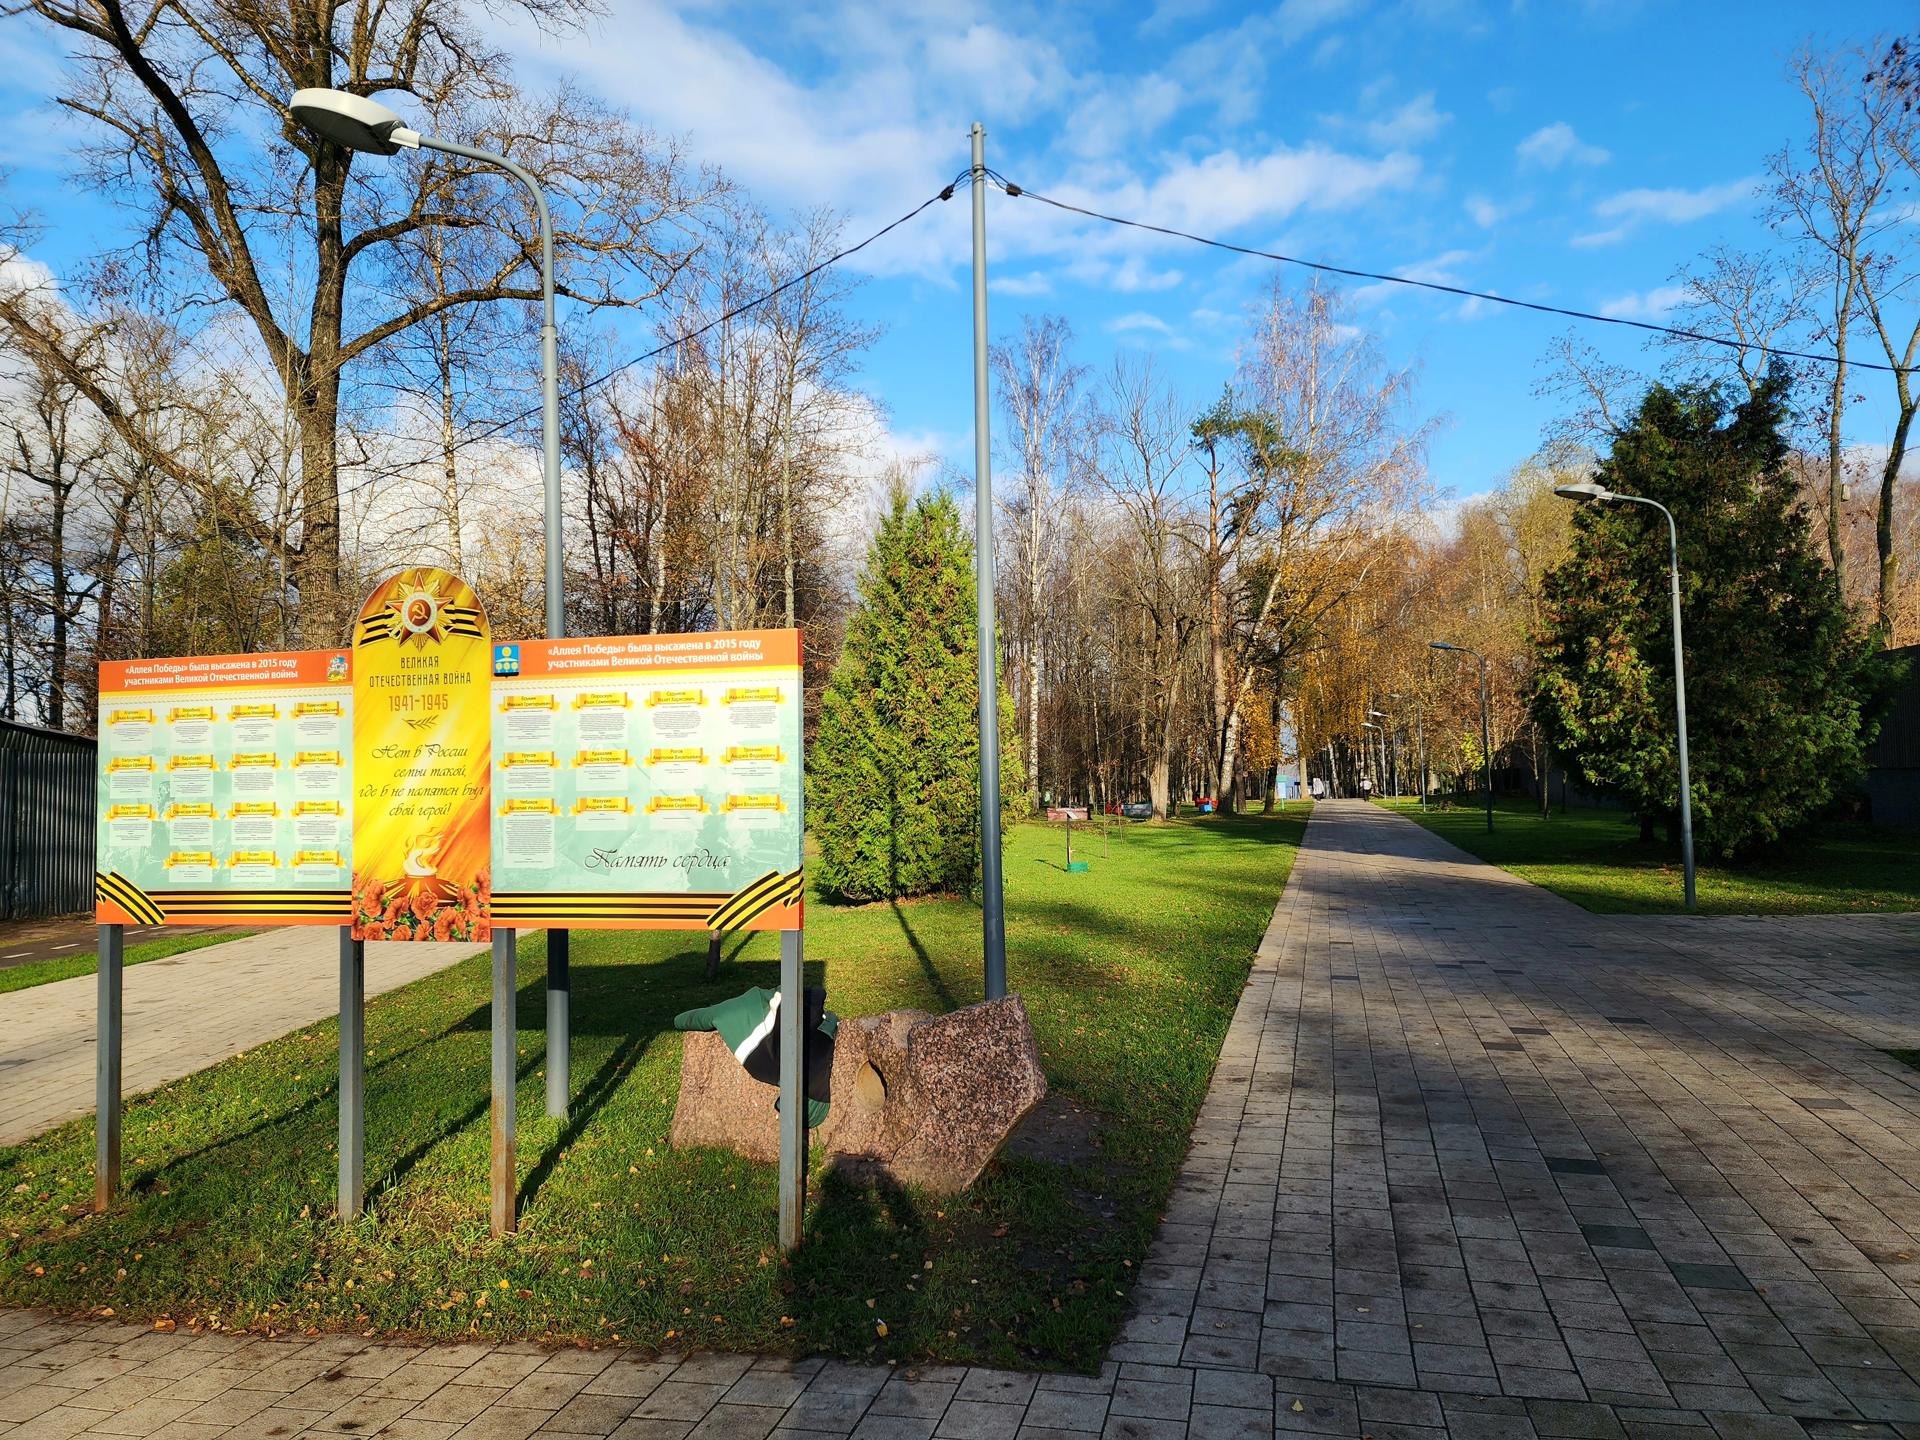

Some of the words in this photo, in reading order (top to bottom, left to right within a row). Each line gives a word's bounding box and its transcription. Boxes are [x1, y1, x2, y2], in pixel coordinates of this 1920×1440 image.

[548, 646, 581, 656] «Аллея
[584, 644, 625, 655] Победы»
[628, 643, 652, 652] была
[655, 642, 703, 651] высажена
[714, 639, 736, 649] 2015
[738, 640, 761, 650] году
[125, 665, 152, 674] «Аллея
[153, 664, 188, 673] Победы»
[189, 662, 209, 671] была
[210, 661, 250, 670] высажена
[258, 658, 277, 668] 2015
[279, 659, 296, 668] году
[401, 656, 439, 669] ВЕЛИКАЯ
[548, 658, 609, 671] участниками
[611, 655, 652, 666] Великой
[654, 652, 728, 664] Отечественной
[730, 651, 763, 661] войны
[124, 677, 174, 688] участниками
[175, 673, 208, 683] Великой
[209, 670, 269, 682] Отечественной
[271, 670, 298, 679] войны
[370, 673, 440, 688] ОТЕЧЕСТВЕННАЯ
[444, 671, 471, 685] ВОЙНА
[389, 694, 448, 711] 1941-1945
[372, 744, 410, 758] Нет
[425, 743, 468, 758] России
[394, 768, 427, 777] семьи
[430, 765, 466, 778] такой,
[359, 784, 377, 797] где
[391, 787, 404, 797] не
[407, 787, 458, 797] памятен
[462, 783, 484, 800] был
[389, 803, 414, 816] свой
[418, 803, 451, 821] герой!
[584, 848, 667, 868] Память
[673, 849, 731, 875] сердца
